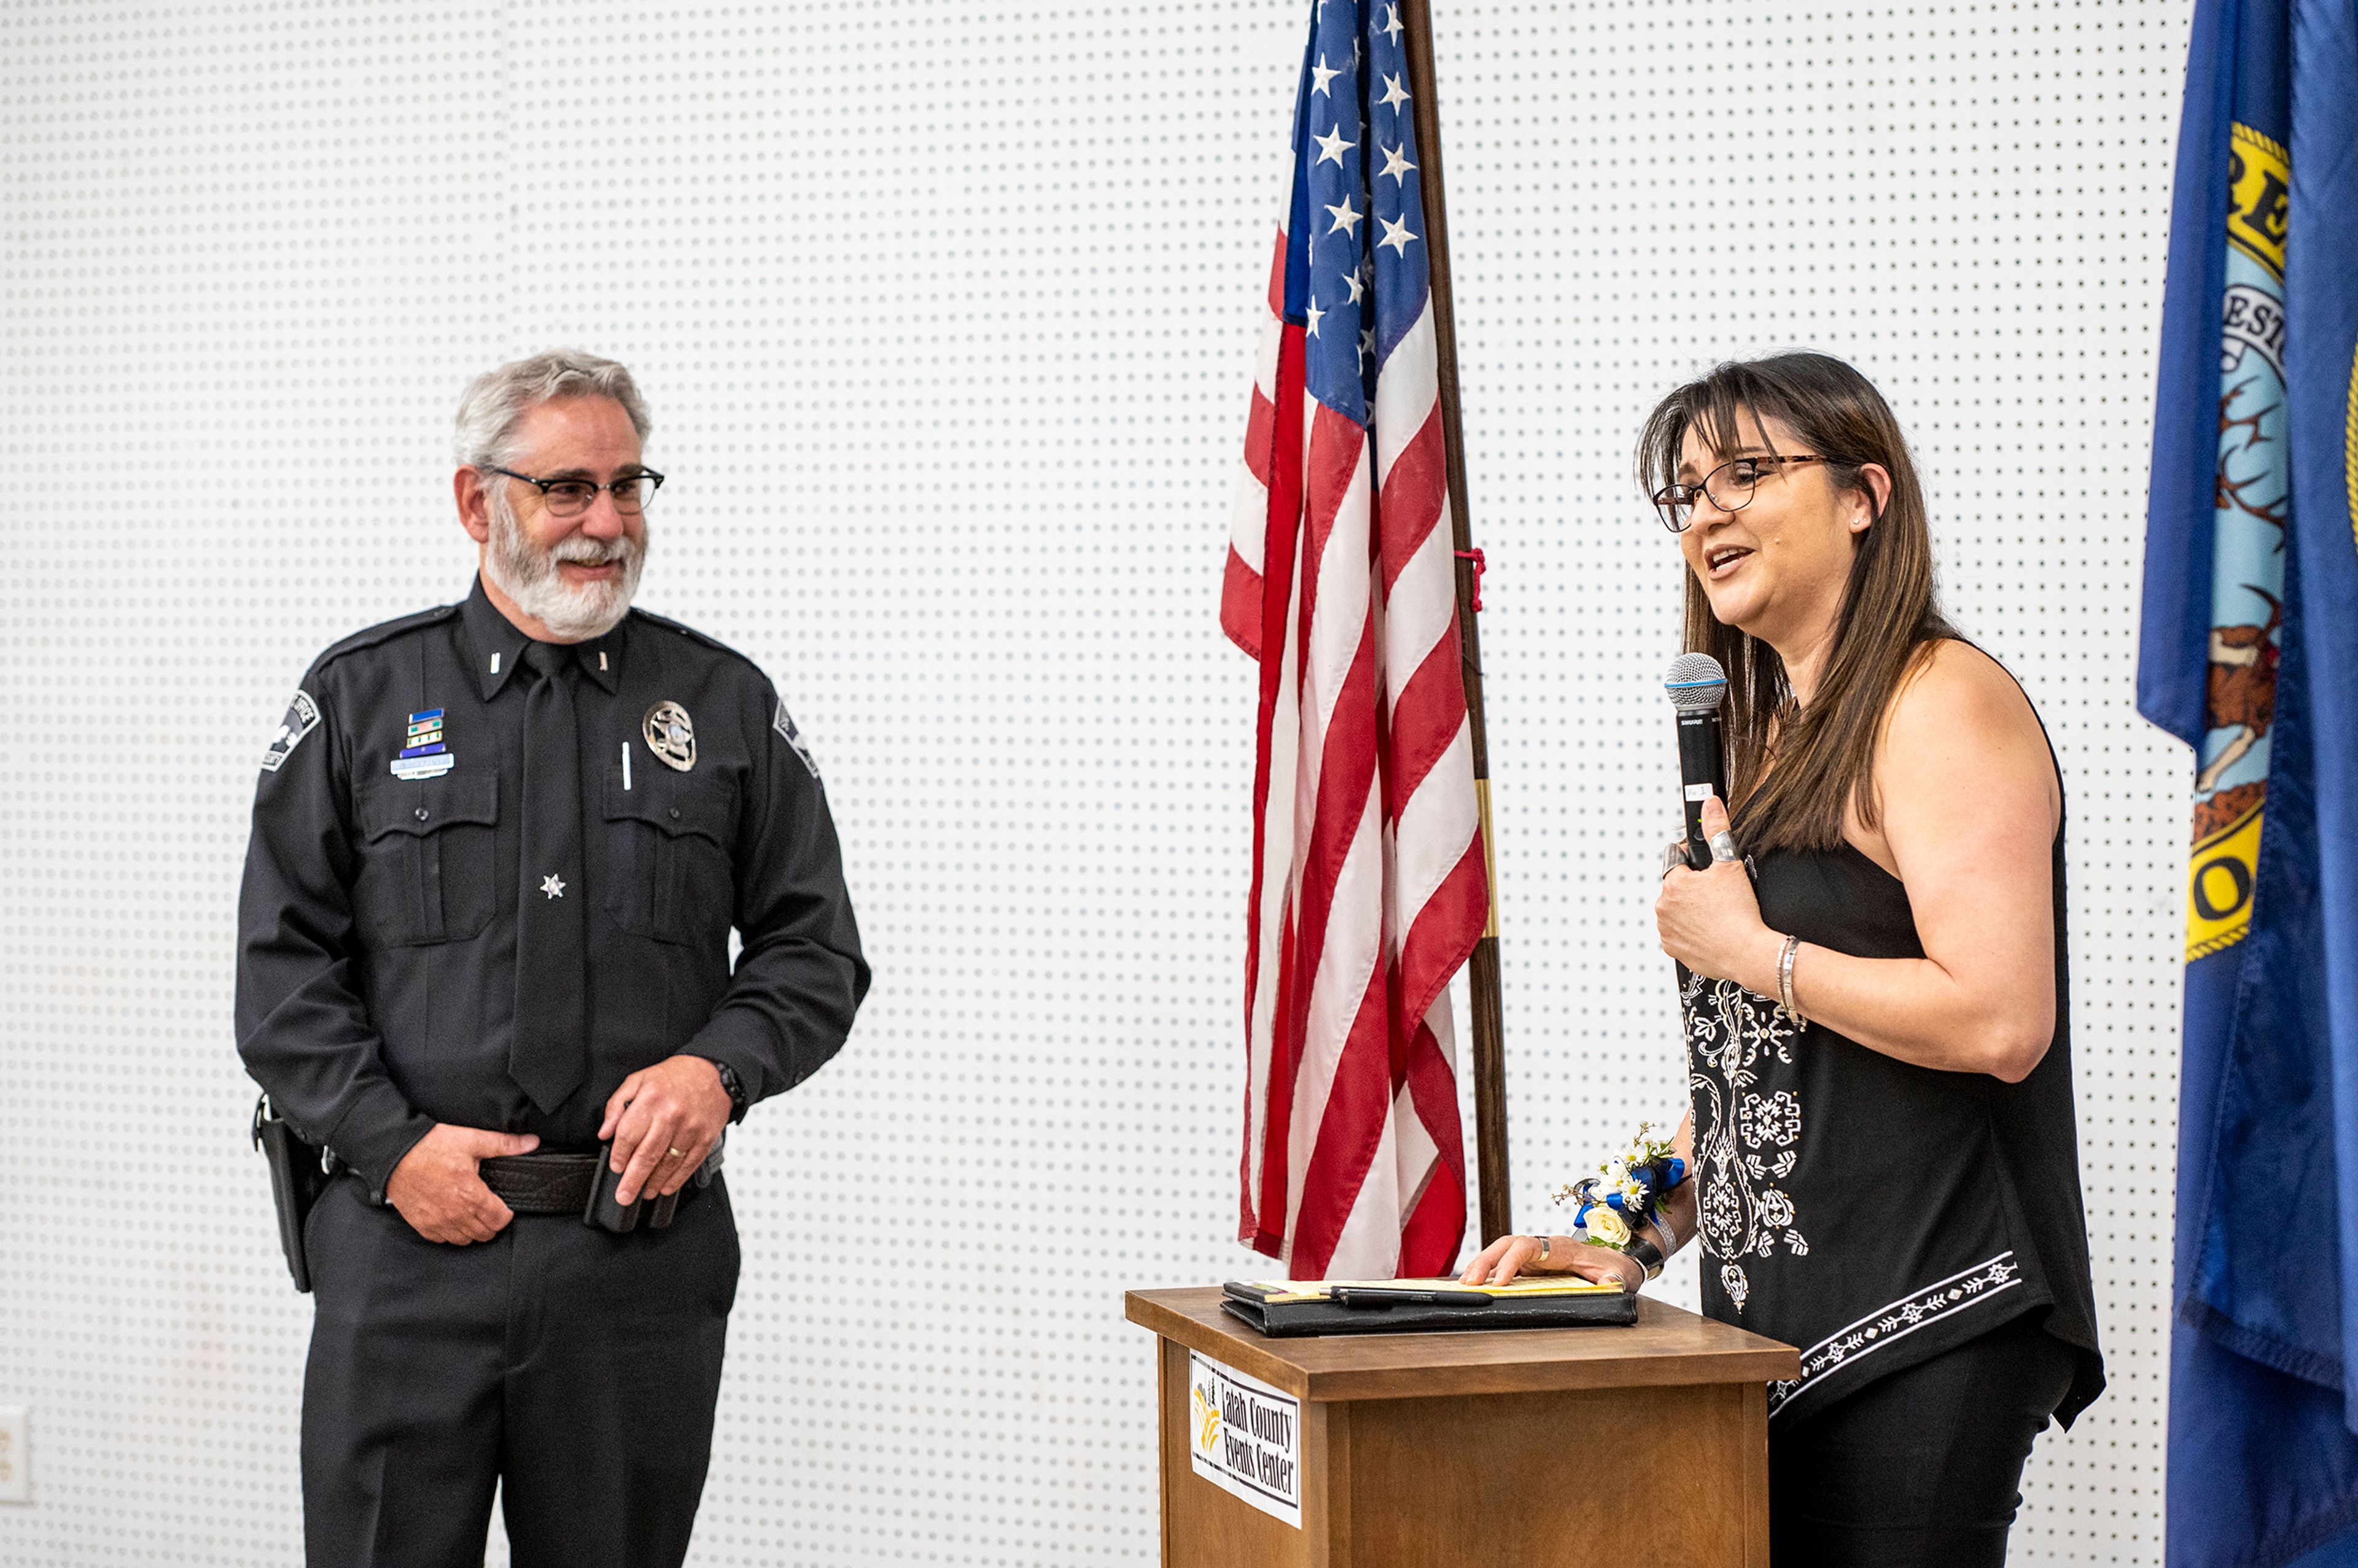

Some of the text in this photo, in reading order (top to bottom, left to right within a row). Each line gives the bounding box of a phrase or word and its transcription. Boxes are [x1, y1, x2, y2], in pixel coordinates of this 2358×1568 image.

[2193, 856, 2251, 921] O
[1221, 1383, 1292, 1454] Latah County
[1223, 1427, 1294, 1495] Events Center
